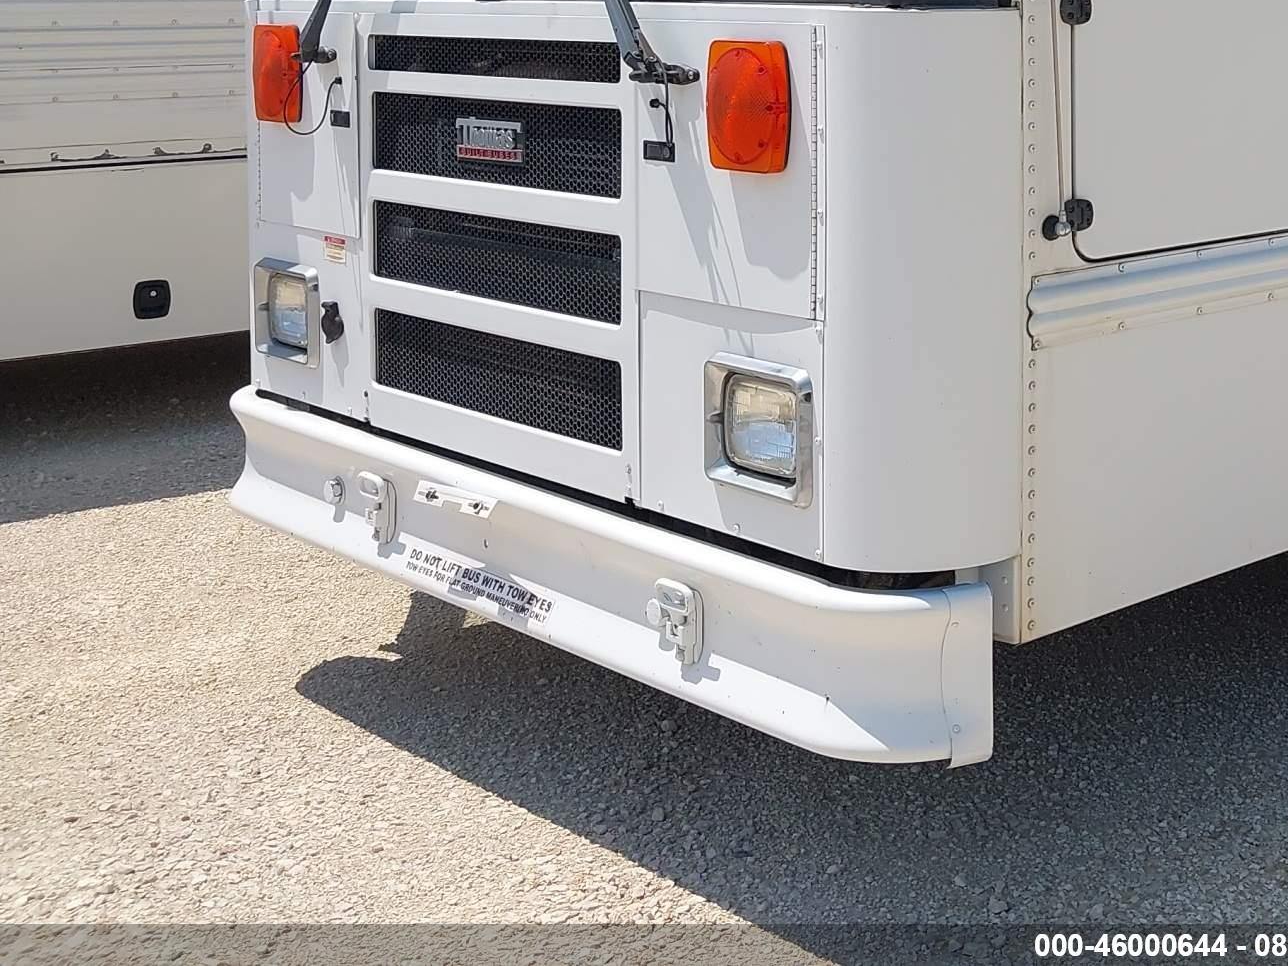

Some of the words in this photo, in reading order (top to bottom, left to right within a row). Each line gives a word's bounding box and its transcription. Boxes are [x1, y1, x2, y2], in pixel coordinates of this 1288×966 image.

[456, 116, 521, 150] Thomas
[406, 561, 418, 571] TOW
[418, 565, 433, 577] EYES
[433, 570, 446, 582] FOR
[445, 576, 461, 587] FLAT
[460, 581, 486, 597] GROUND
[529, 610, 547, 623] ONLY
[410, 548, 423, 561] DO
[423, 554, 443, 570] NOT
[442, 560, 462, 576] LIFT
[461, 568, 481, 583] BUS
[481, 575, 506, 593] WITH
[506, 585, 528, 602] TOW
[526, 592, 553, 613] EYES
